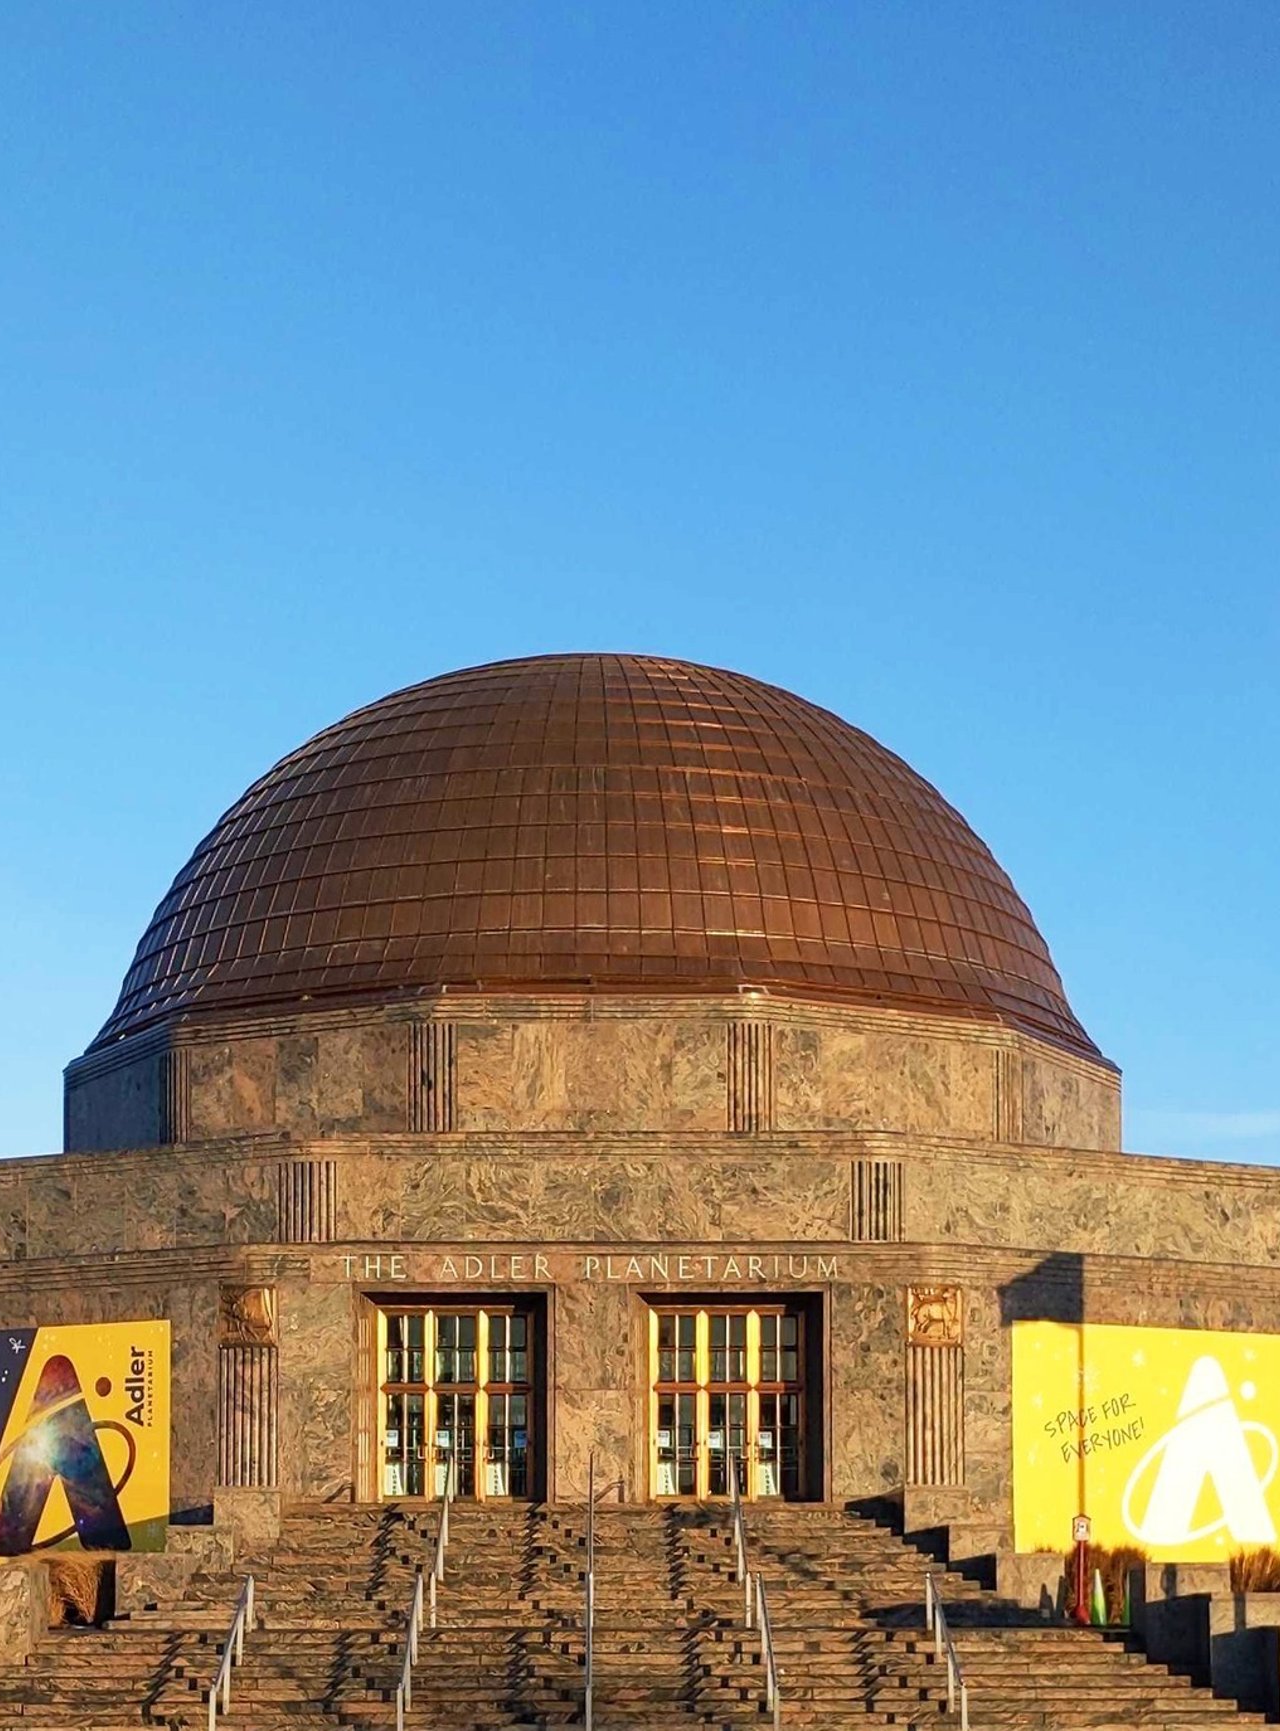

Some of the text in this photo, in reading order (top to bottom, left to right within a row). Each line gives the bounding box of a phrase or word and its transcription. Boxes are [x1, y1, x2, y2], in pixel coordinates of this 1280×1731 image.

[332, 1252, 839, 1280] THE ADLER PLANETARIUM
[125, 1345, 145, 1428] Adler
[1043, 1392, 1137, 1439] SPACE FOR
[1060, 1415, 1145, 1464] EVERYONE!
